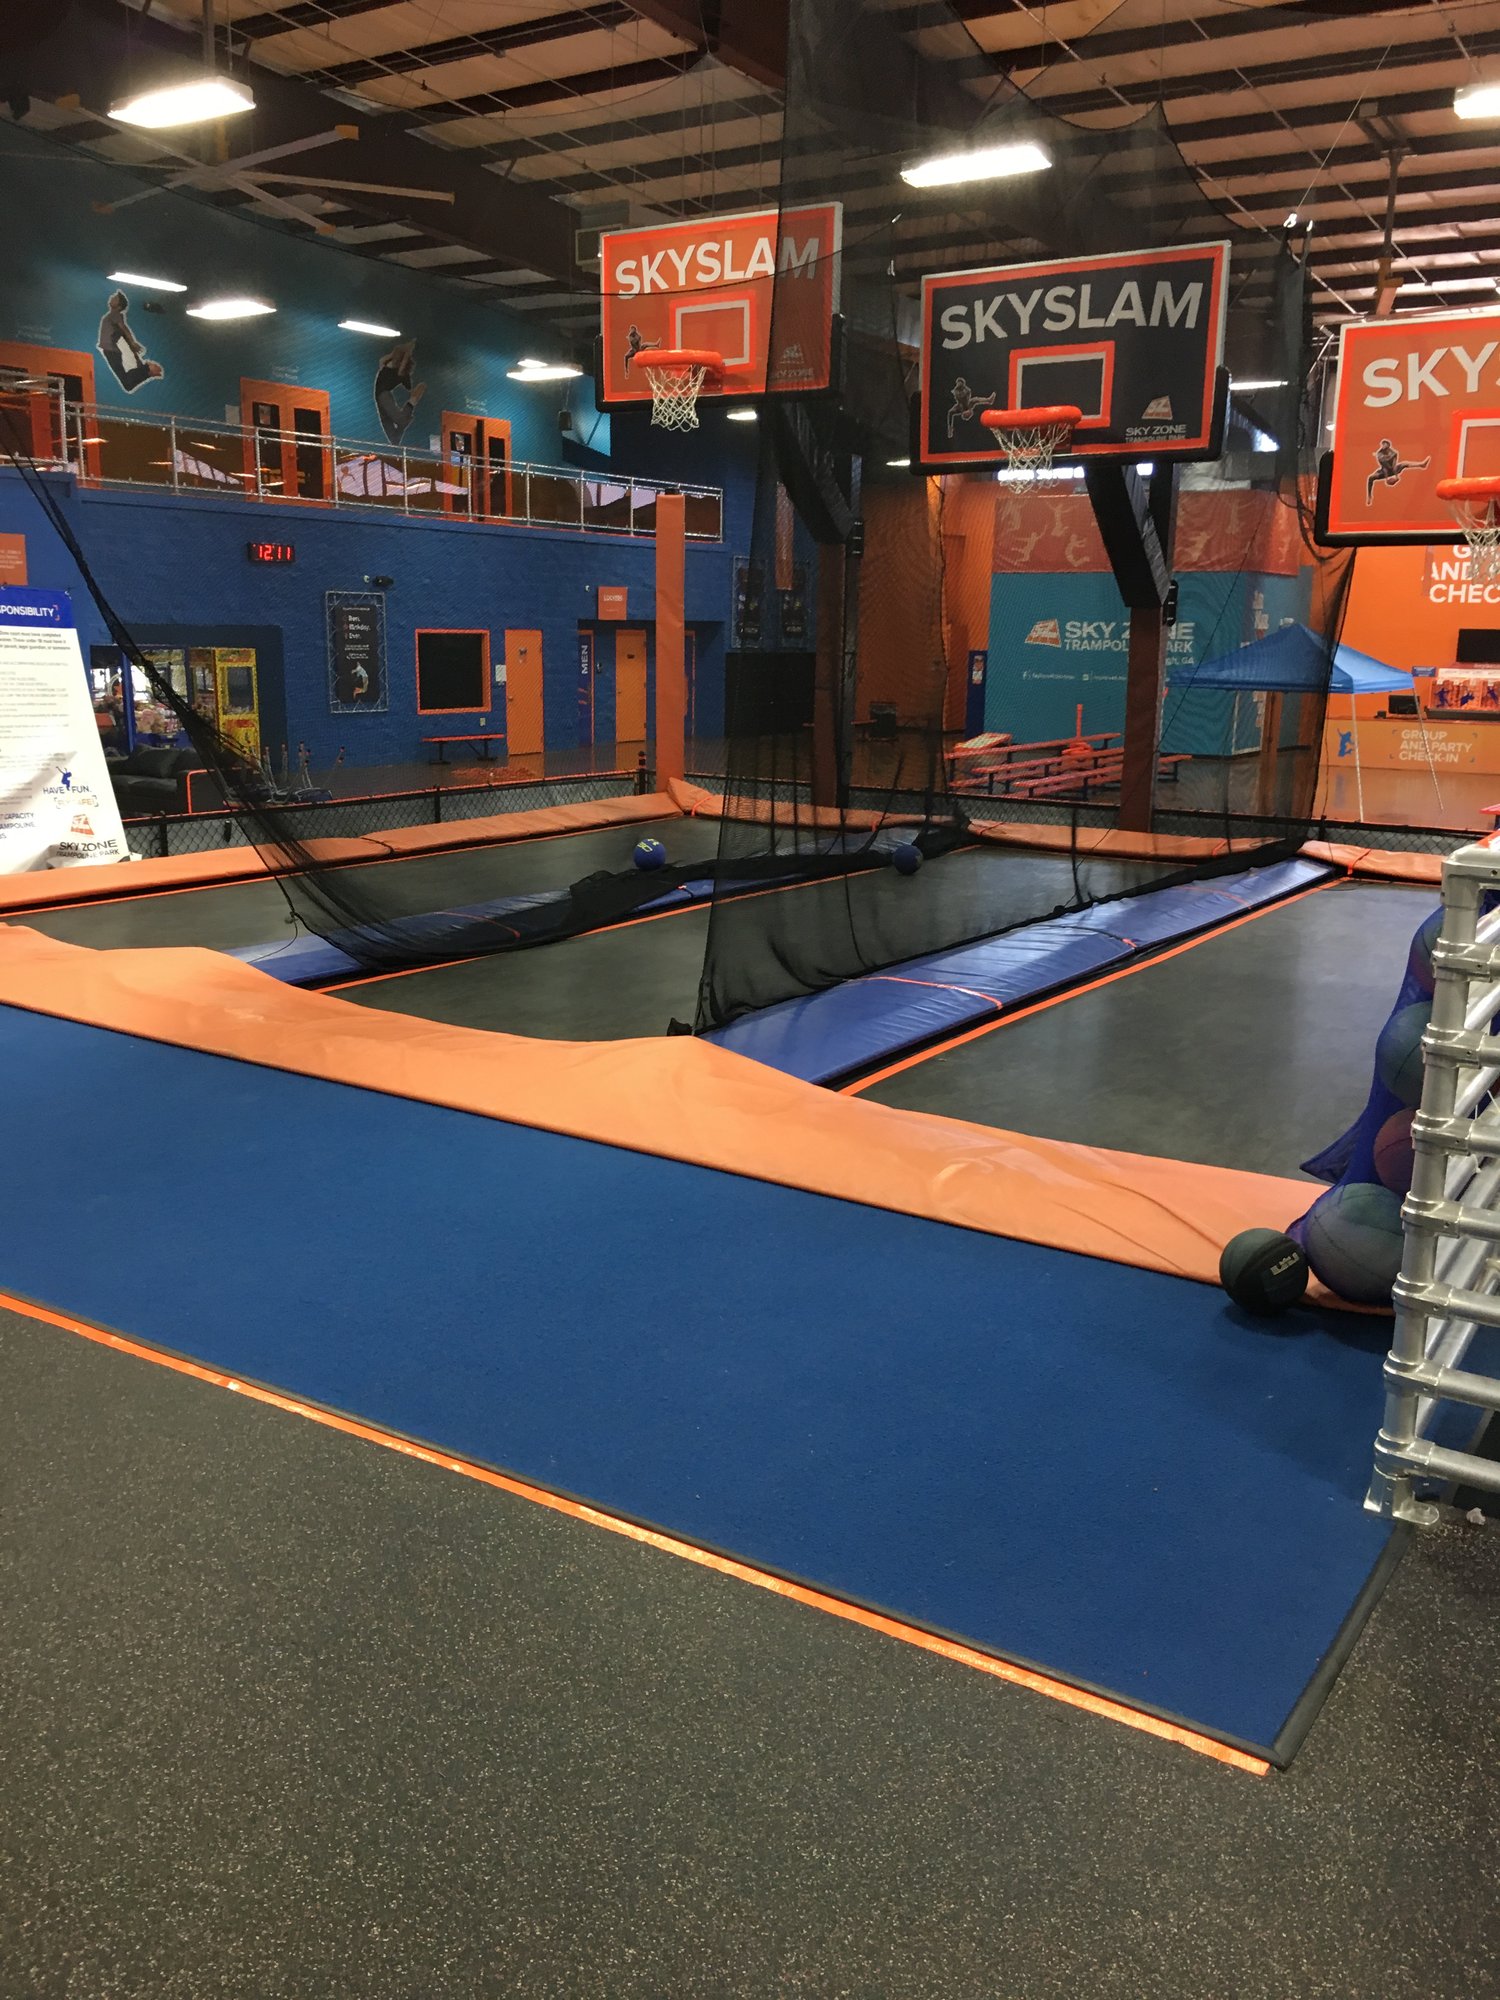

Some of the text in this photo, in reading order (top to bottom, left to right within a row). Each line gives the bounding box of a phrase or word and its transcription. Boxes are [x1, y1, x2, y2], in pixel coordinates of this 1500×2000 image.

[615, 236, 819, 300] SKYSLAM
[940, 281, 1204, 350] SKYSLAM
[1362, 341, 1500, 408] SKY
[1125, 424, 1187, 437] SKY ZONE
[0, 604, 54, 617] PONSIBILITY
[1065, 621, 1196, 641] SKY ZNE
[1064, 639, 1194, 653] TRAMPOL ARK
[581, 645, 589, 675] MEN
[1401, 729, 1448, 740] GROUP
[1400, 740, 1473, 752] AND PARTY
[1399, 750, 1459, 763] CHECK-IN
[43, 786, 65, 795] HAVE
[59, 838, 118, 852] SKY ZONE
